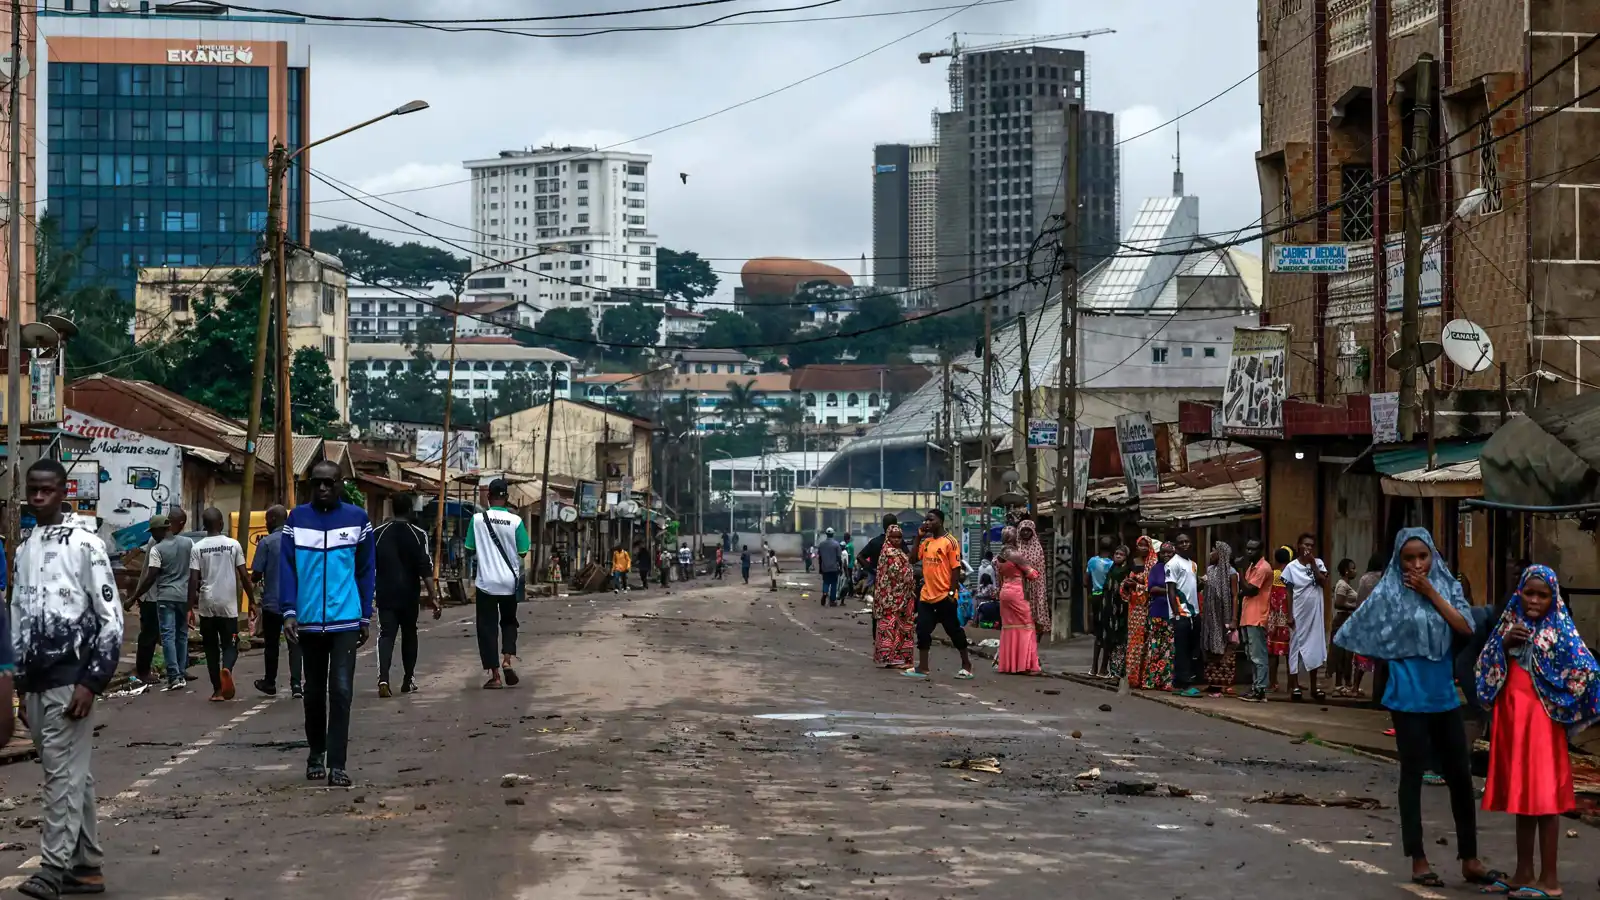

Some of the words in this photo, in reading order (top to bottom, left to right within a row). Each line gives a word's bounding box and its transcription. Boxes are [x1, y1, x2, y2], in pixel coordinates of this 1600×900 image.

[167, 50, 235, 63] EKANG
[1282, 247, 1312, 258] CABINET
[1315, 247, 1347, 258] MEDICAL
[92, 441, 145, 454] Moderne
